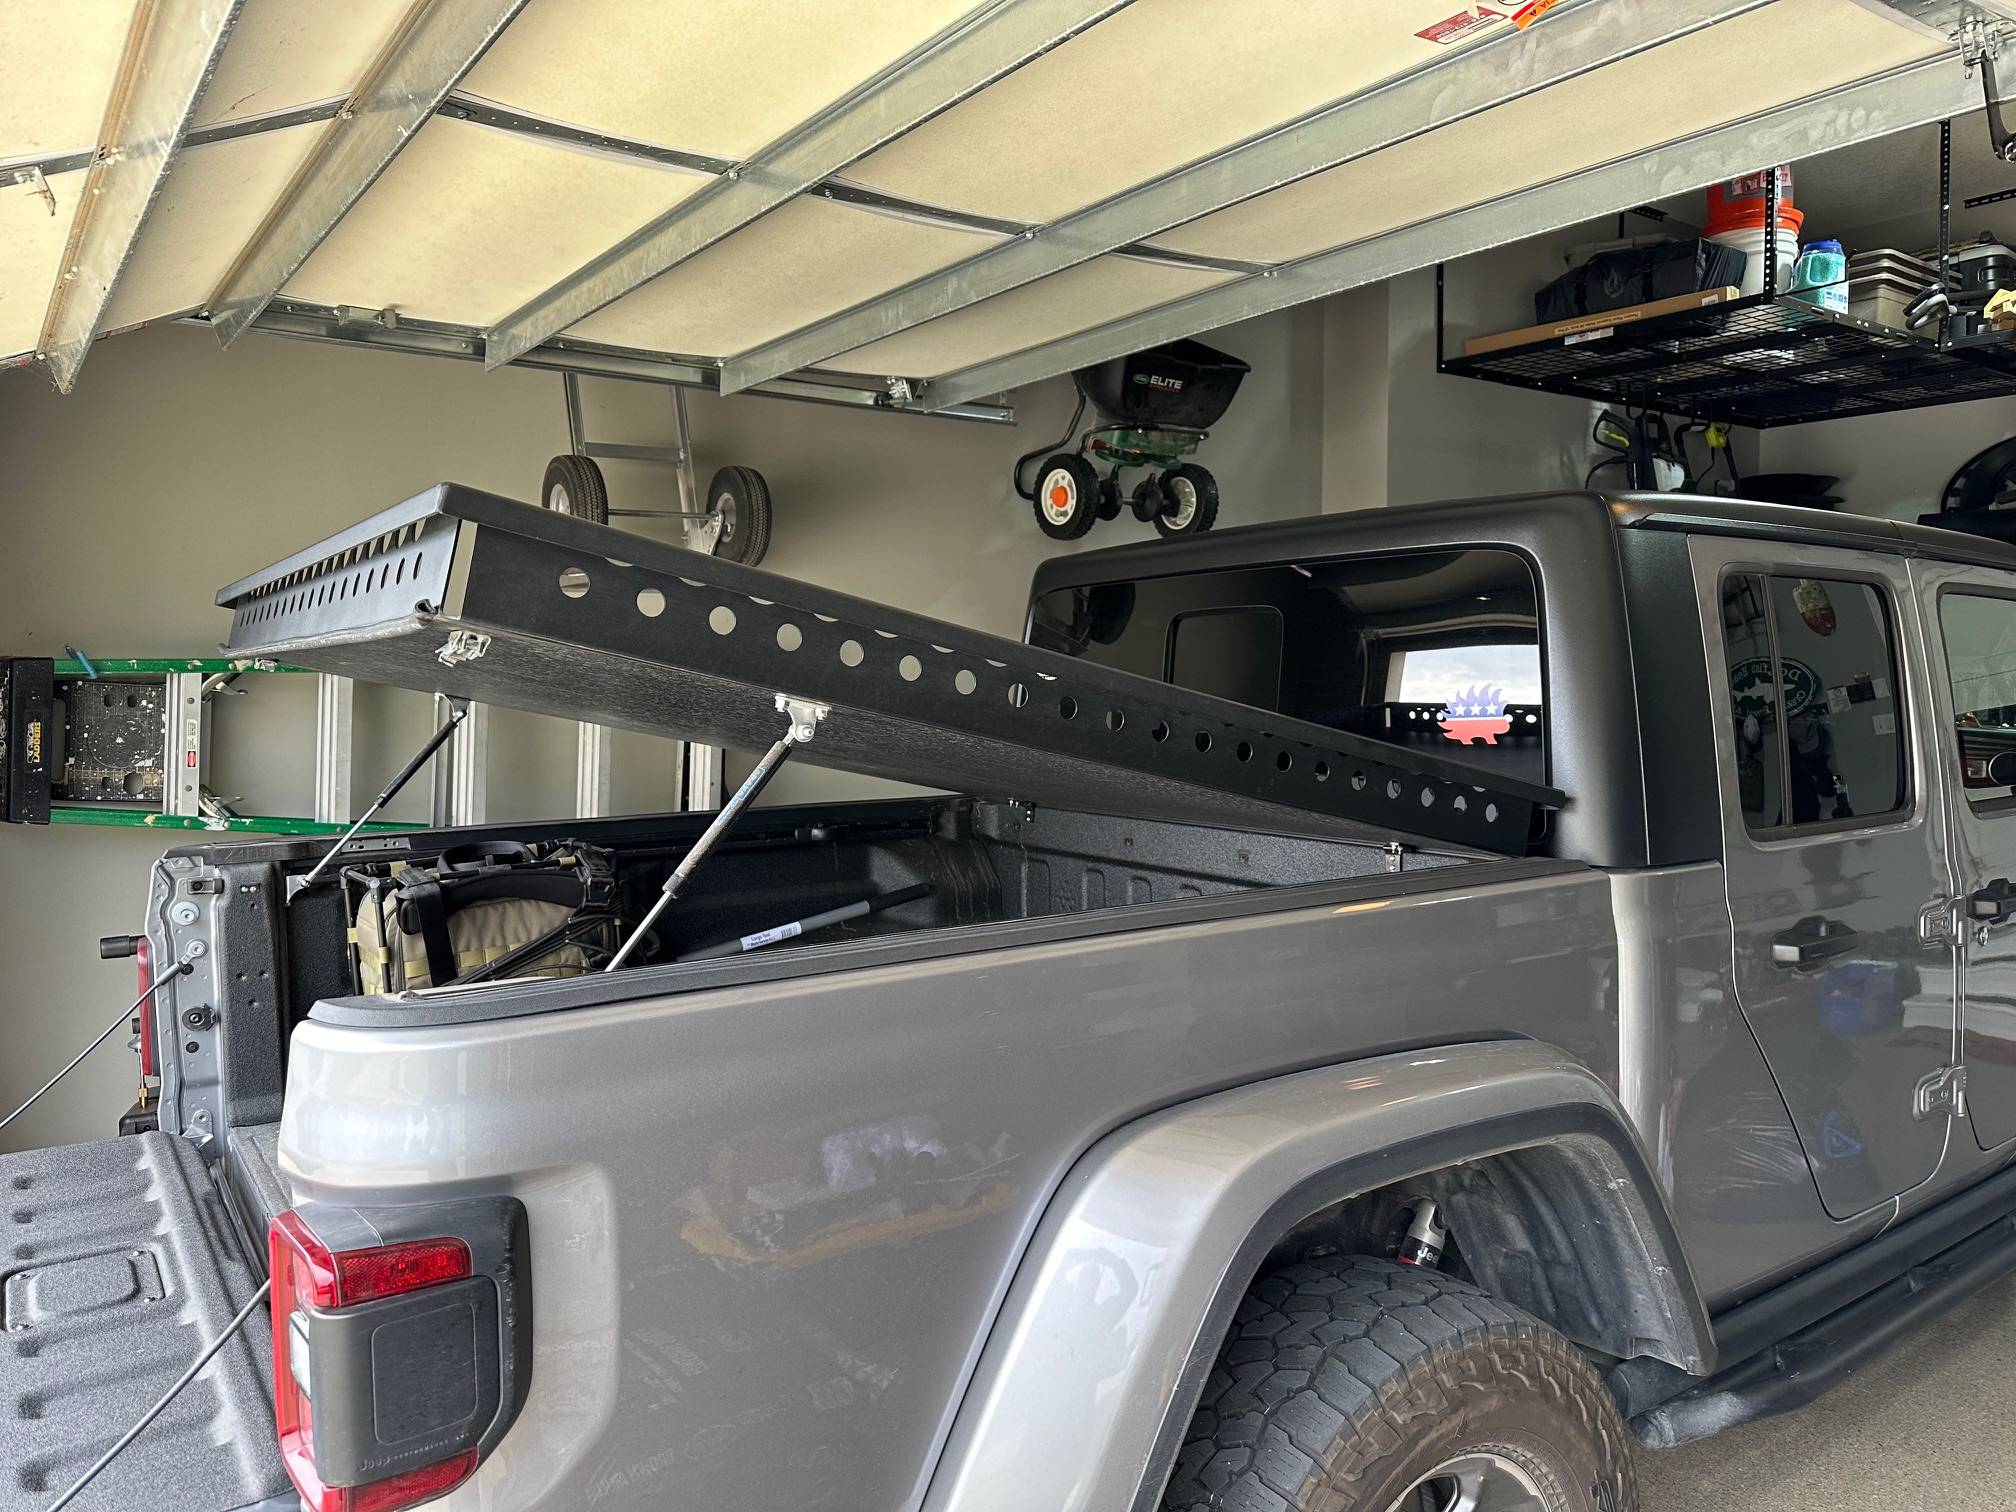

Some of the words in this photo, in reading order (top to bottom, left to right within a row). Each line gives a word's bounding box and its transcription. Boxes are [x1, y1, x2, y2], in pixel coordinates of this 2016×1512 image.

[1150, 375, 1183, 389] ELITE
[33, 721, 41, 763] LADDERS
[1417, 1246, 1439, 1264] Jee
[360, 1456, 391, 1471] Jeep
